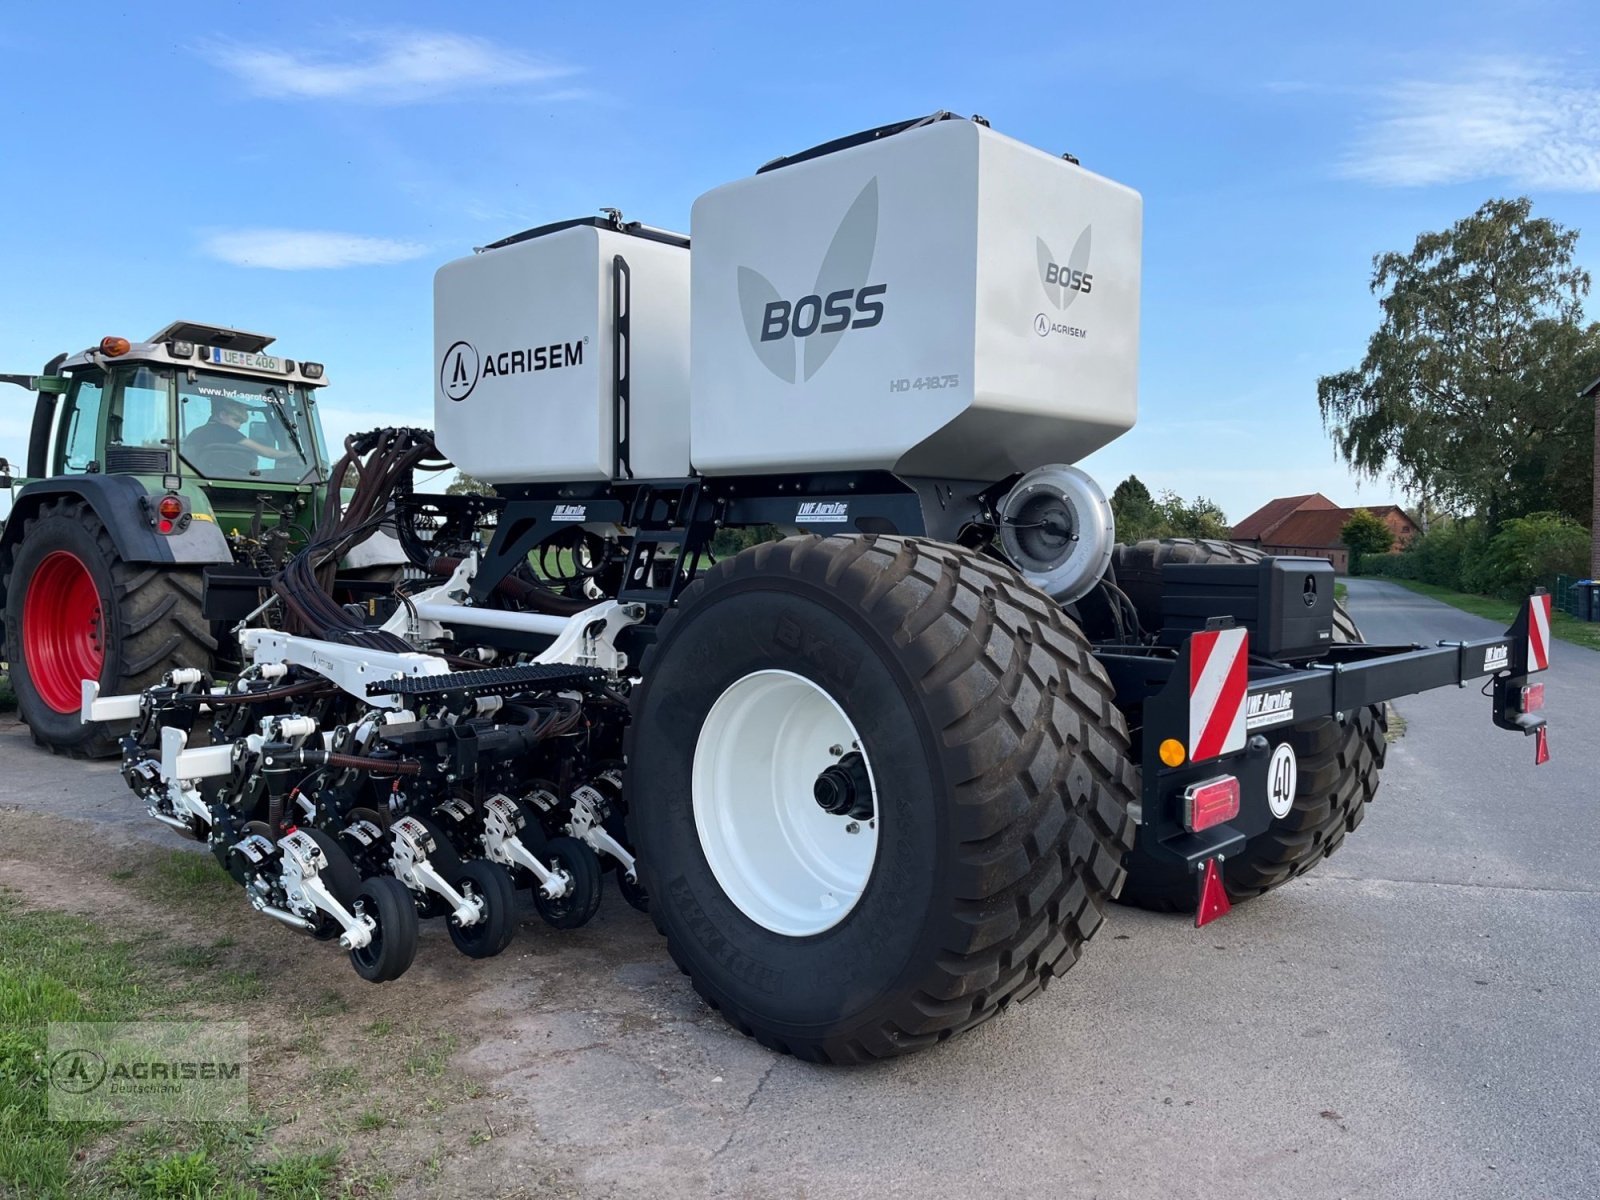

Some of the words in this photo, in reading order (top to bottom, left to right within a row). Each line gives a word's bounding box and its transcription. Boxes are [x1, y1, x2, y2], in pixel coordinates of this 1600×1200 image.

[1045, 262, 1093, 294] BOSS
[760, 283, 887, 342] BOSS
[1051, 323, 1087, 338] AGRISEM
[224, 351, 239, 364] UE
[255, 356, 275, 369] 406
[890, 379, 911, 393] HD
[1273, 755, 1291, 803] 40
